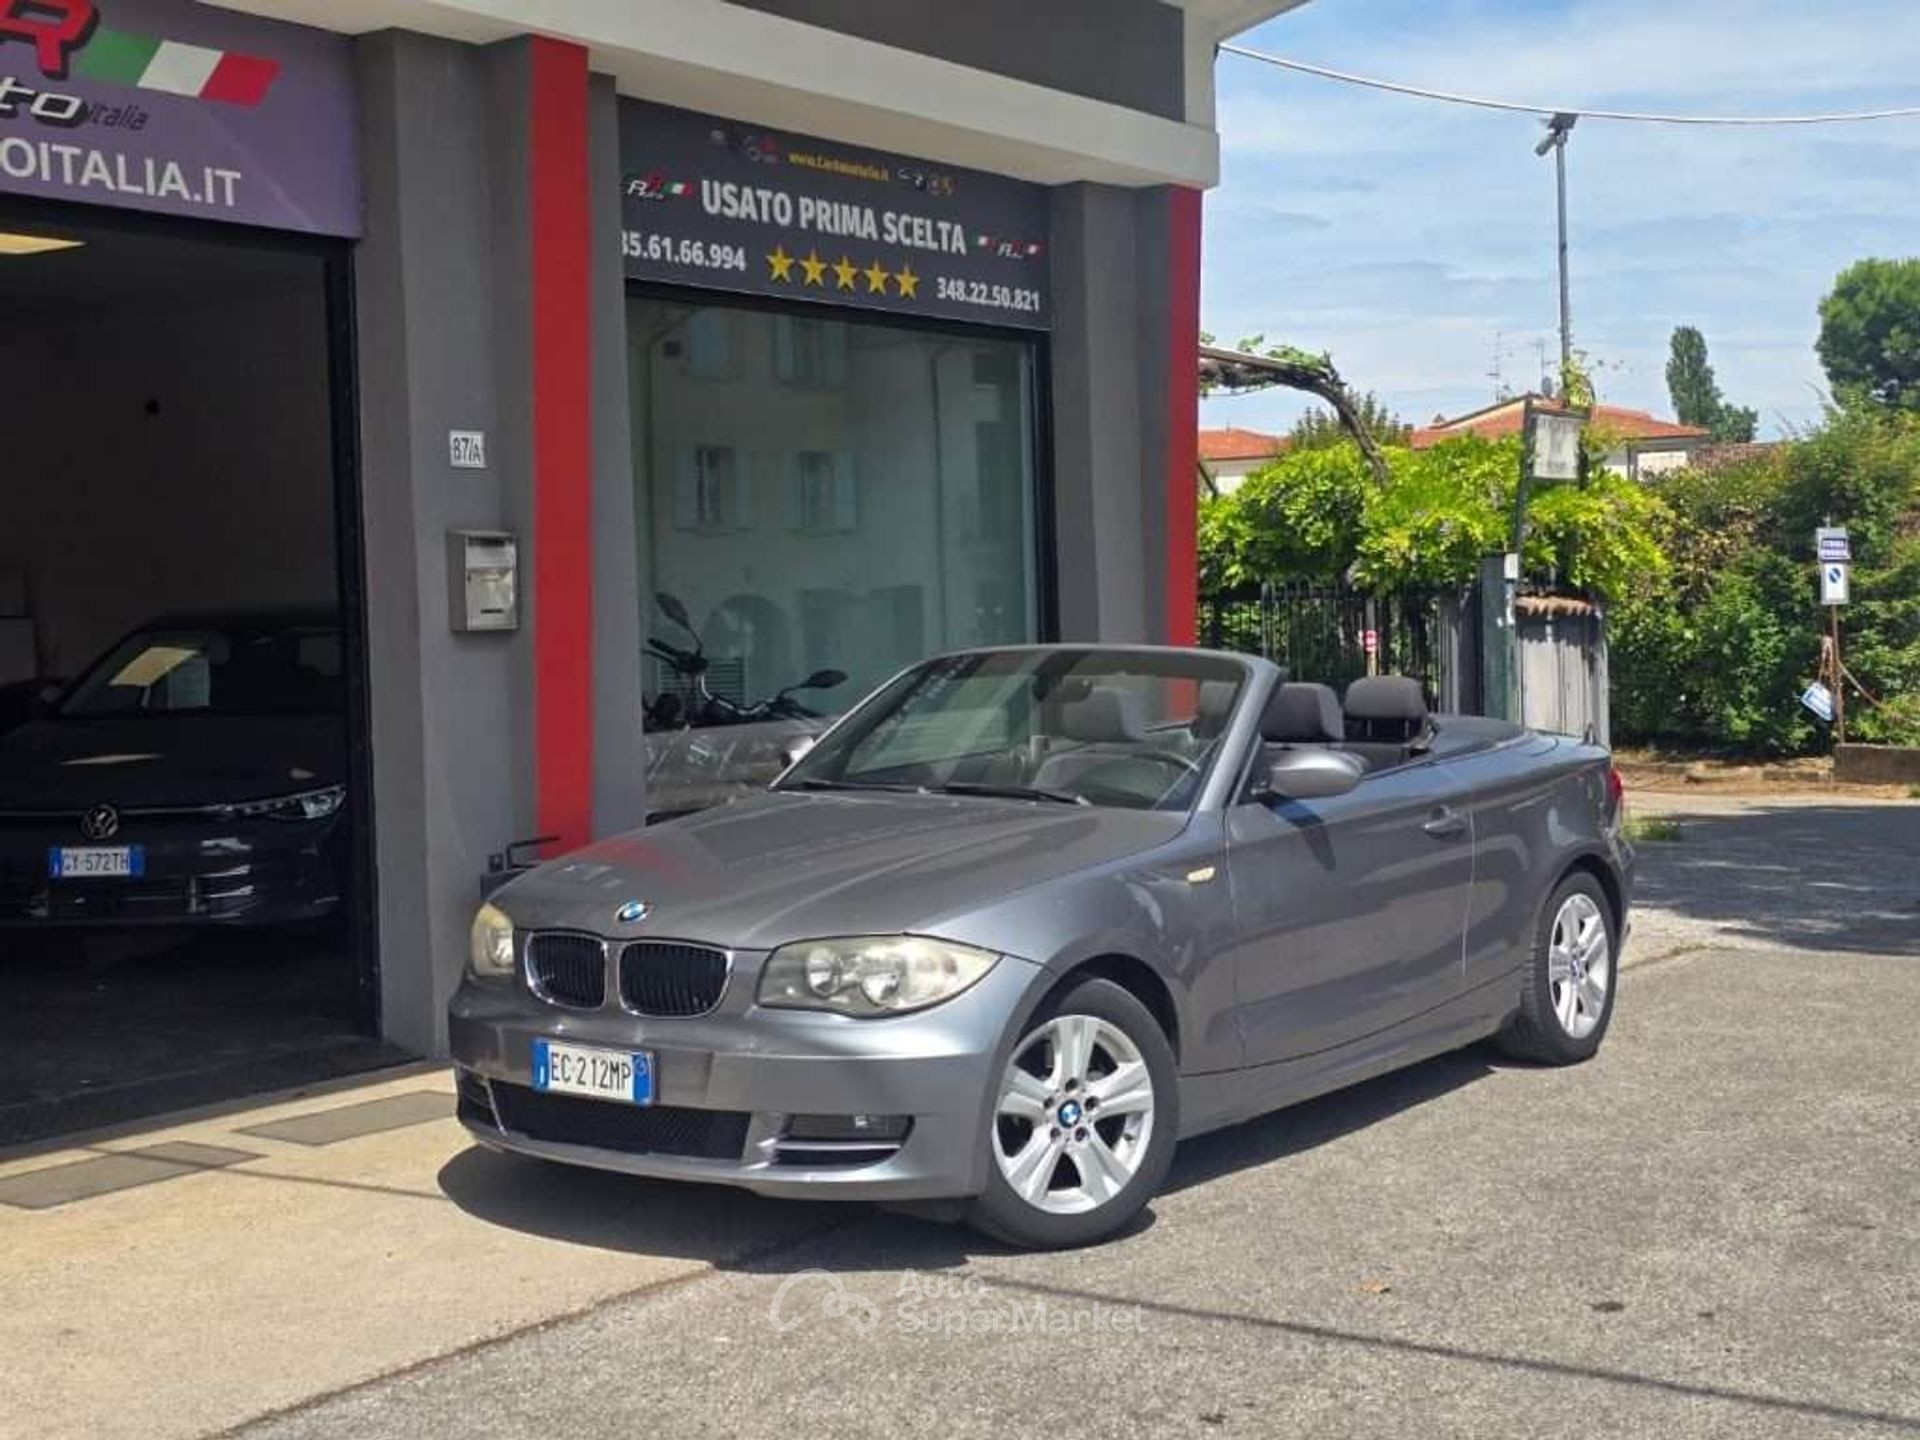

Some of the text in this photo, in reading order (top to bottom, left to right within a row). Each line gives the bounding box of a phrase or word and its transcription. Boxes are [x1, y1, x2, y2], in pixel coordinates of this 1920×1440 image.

[702, 179, 967, 255] USATO PRIMA SCELTA
[936, 277, 1040, 312] 348.22.50.821
